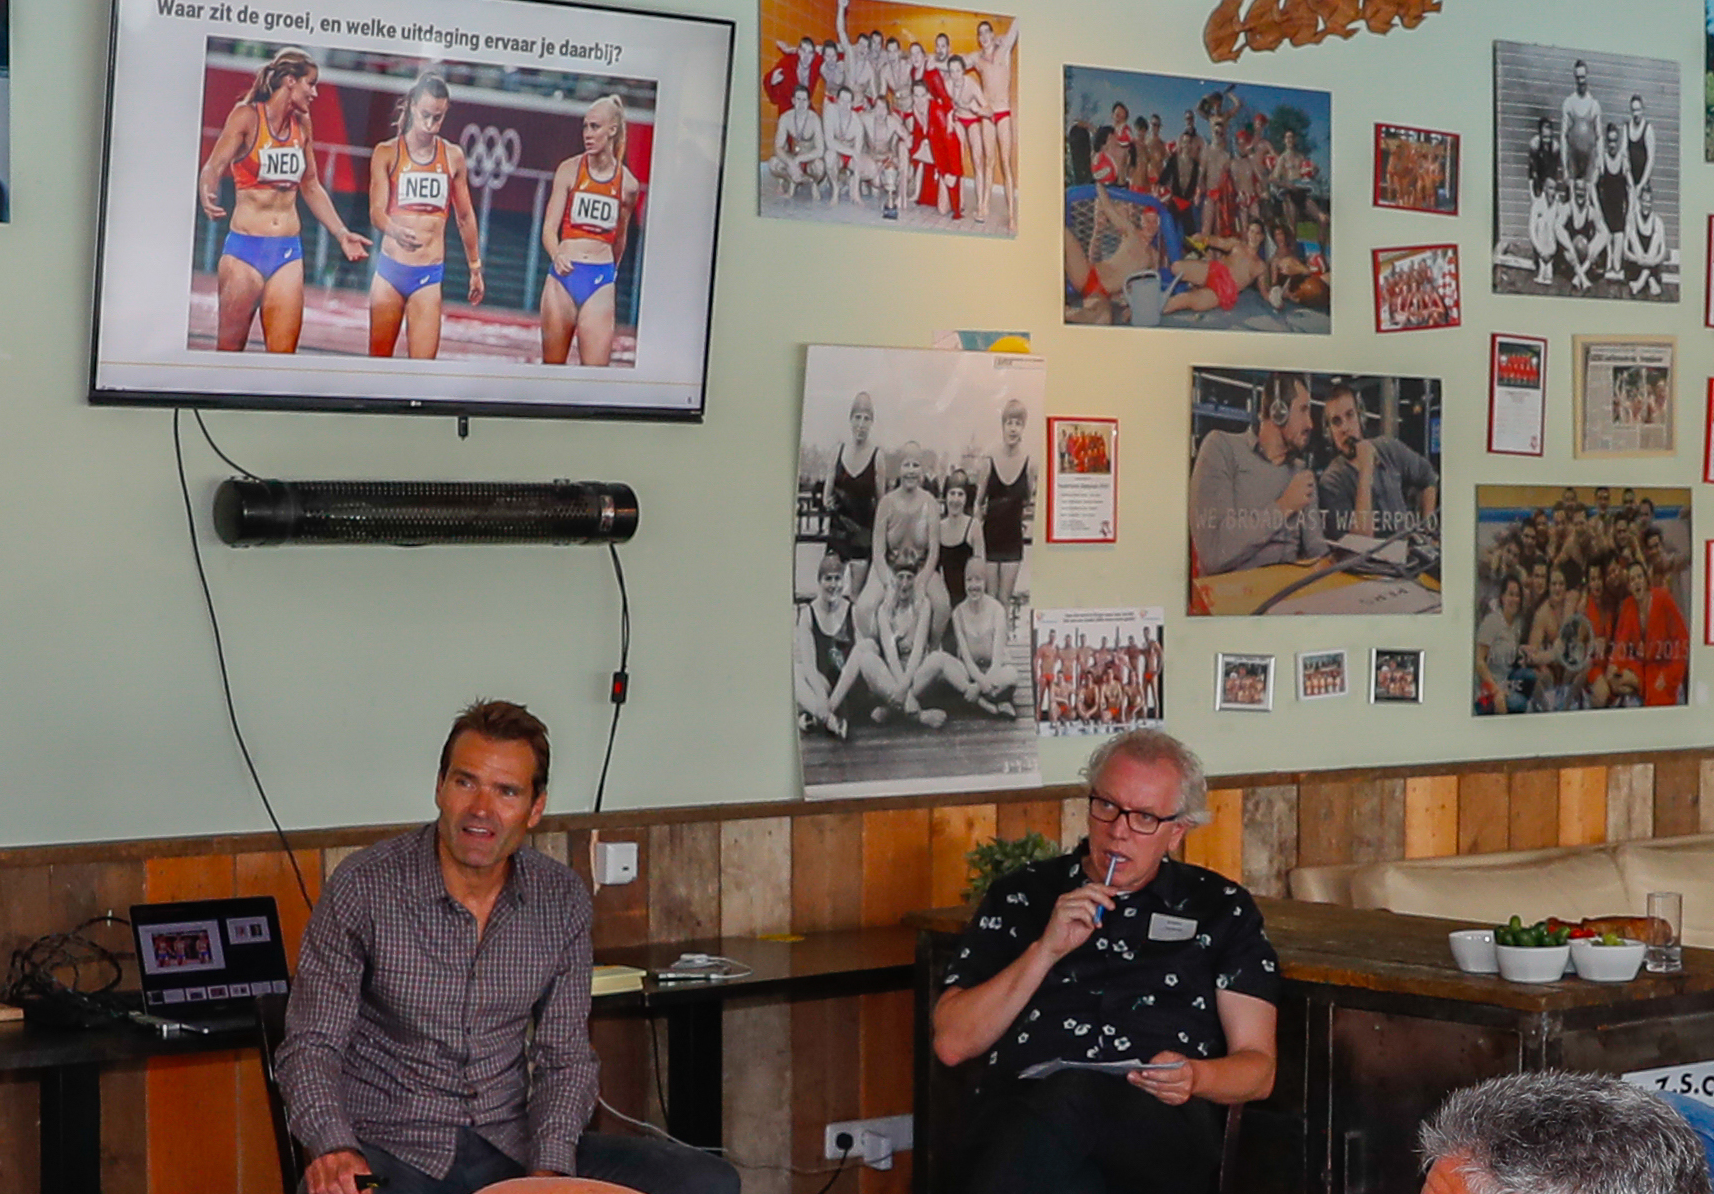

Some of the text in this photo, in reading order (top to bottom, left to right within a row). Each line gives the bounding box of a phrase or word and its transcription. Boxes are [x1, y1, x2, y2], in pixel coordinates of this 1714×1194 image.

[156, 0, 623, 66] Waar zit de groei, en welke uitdaging ervaar je daarbij?
[265, 153, 300, 175] NED
[405, 177, 441, 199] NED
[577, 199, 611, 222] NED
[1194, 507, 1440, 534] WE BROADCAST WATERPOLO
